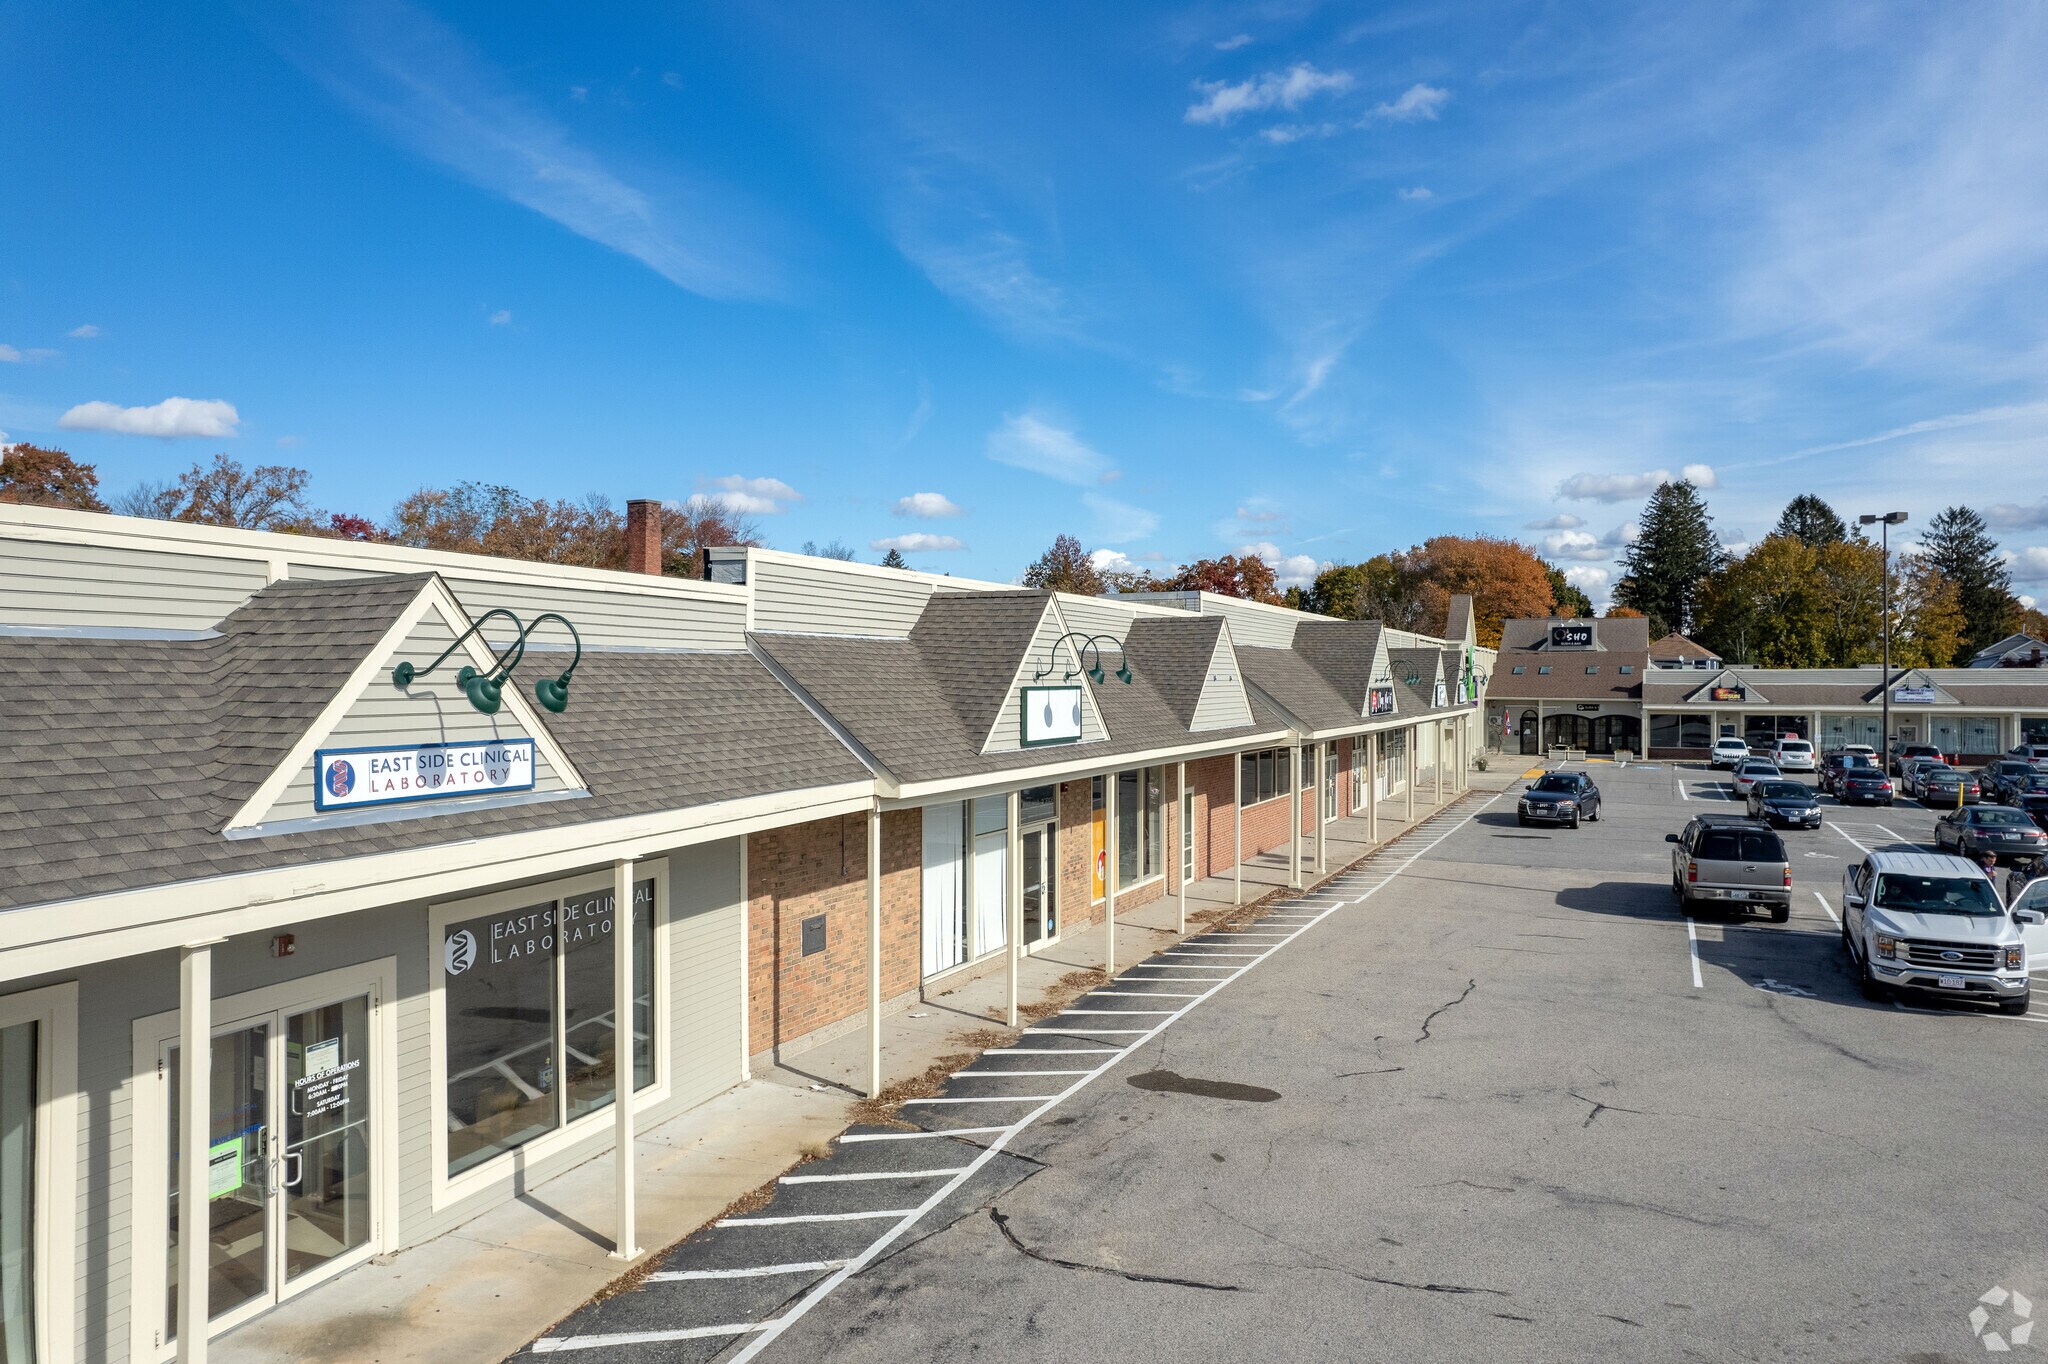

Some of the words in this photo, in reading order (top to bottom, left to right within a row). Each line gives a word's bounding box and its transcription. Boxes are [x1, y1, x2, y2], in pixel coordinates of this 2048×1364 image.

[371, 756, 413, 774] EAST
[419, 754, 454, 769] SIDE
[460, 748, 530, 767] CLINICAL
[371, 767, 510, 793] LABORATORY
[494, 914, 538, 940] EAST
[543, 904, 580, 928] SIDE
[294, 1074, 316, 1088] HOURS
[316, 1072, 325, 1080] OF
[325, 1059, 360, 1076] OPERATIONS
[307, 1081, 330, 1093] MONDAY
[332, 1074, 349, 1084] FRIDAY
[307, 1088, 327, 1100] 6:30AM
[316, 1094, 341, 1107] SATURDAY
[306, 1106, 326, 1118] 7:00AM
[330, 1097, 350, 1109] 12:00PM
